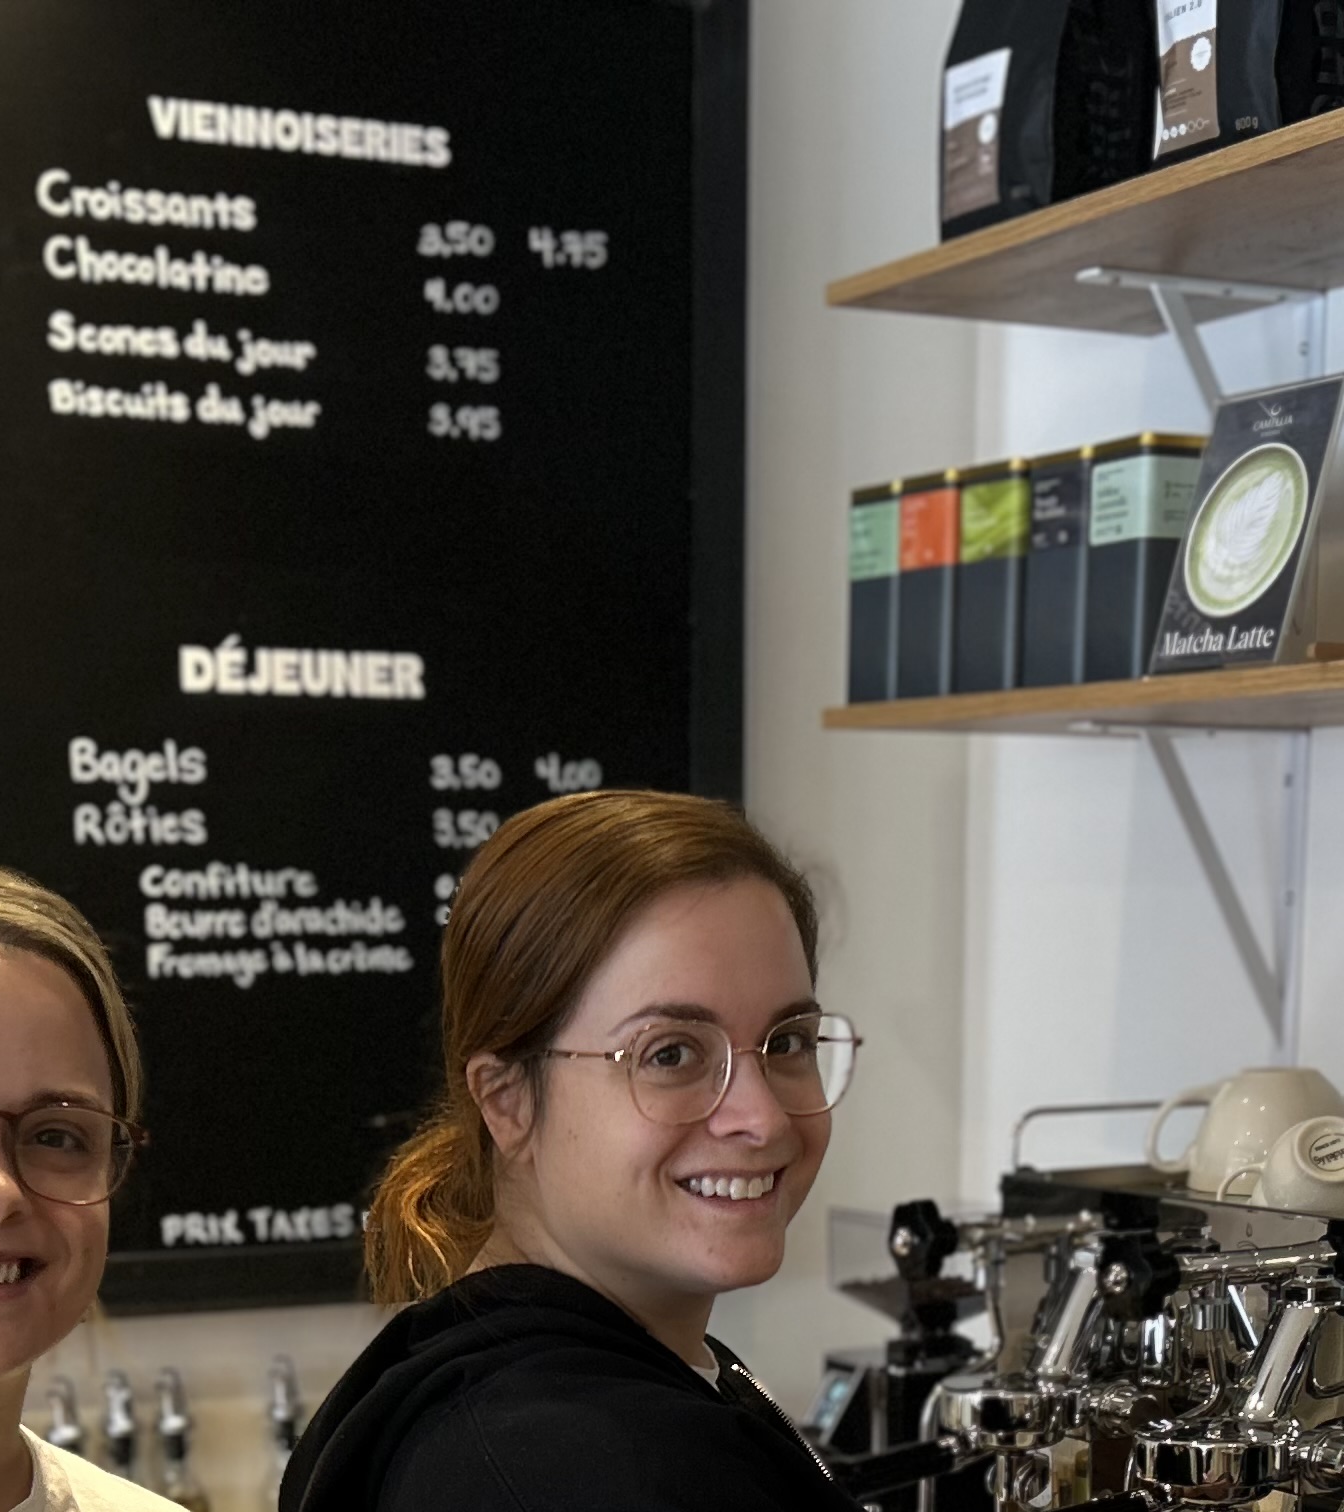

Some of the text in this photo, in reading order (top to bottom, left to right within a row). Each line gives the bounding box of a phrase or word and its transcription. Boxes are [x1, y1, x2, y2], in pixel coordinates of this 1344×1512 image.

[148, 96, 451, 167] VIENNOISERIES
[36, 169, 256, 231] Croissants
[43, 235, 269, 295] Chocolatine
[48, 310, 180, 358] Scones
[183, 320, 232, 361] du
[236, 329, 316, 375] jour
[48, 379, 190, 422] Biscuits
[196, 383, 245, 424] du
[248, 395, 320, 439] jour
[179, 634, 424, 699] DÉJEUNER
[1161, 625, 1275, 657] Matcha Latte
[69, 737, 206, 805] Bagels
[74, 801, 207, 845] Rôties
